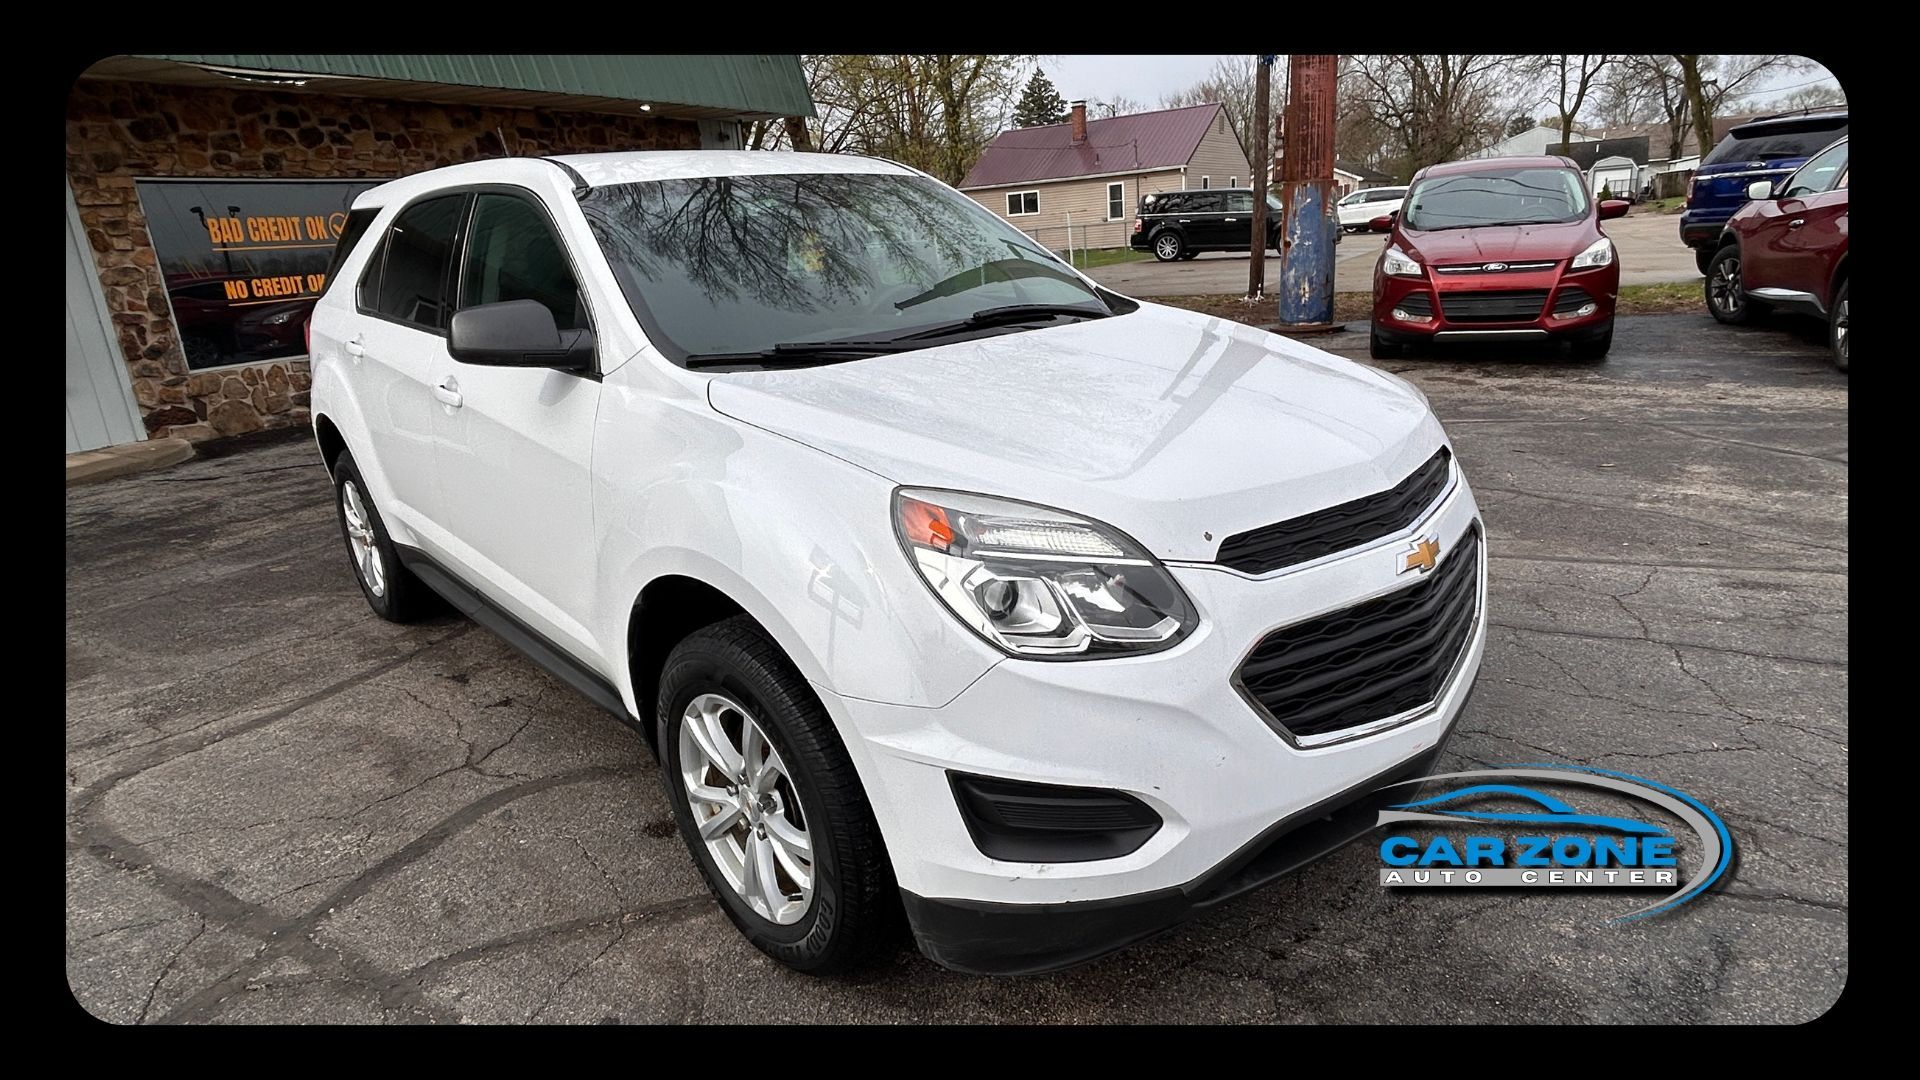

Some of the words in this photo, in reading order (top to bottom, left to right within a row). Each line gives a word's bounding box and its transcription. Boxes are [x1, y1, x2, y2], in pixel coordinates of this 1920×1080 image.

[207, 217, 244, 243] BAD
[247, 216, 303, 242] CREDIT
[305, 215, 328, 240] OK
[224, 281, 249, 299] NO
[252, 276, 304, 297] CREDIT
